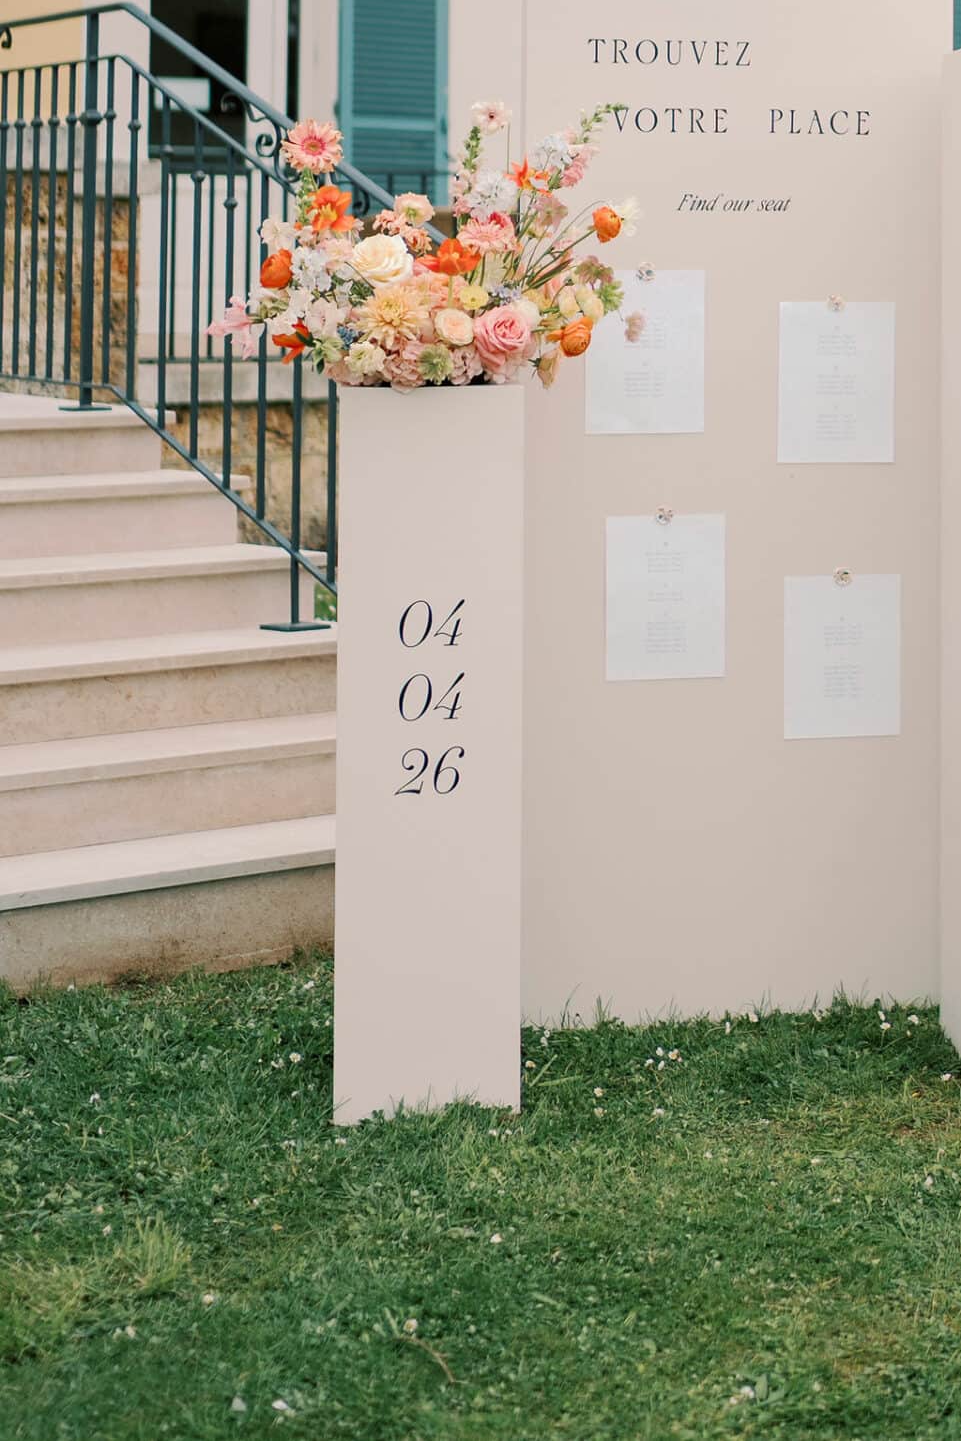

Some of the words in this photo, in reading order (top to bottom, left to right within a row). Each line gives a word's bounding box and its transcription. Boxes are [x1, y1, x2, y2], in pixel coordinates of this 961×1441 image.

[587, 38, 752, 67] TROUVEZ
[613, 107, 729, 134] VOTRE
[768, 108, 872, 136] PLACE
[676, 192, 722, 213] Find
[722, 197, 756, 213] our
[756, 196, 792, 213] seat
[398, 598, 466, 649] 04
[398, 671, 466, 722] 04
[393, 745, 466, 797] 26
